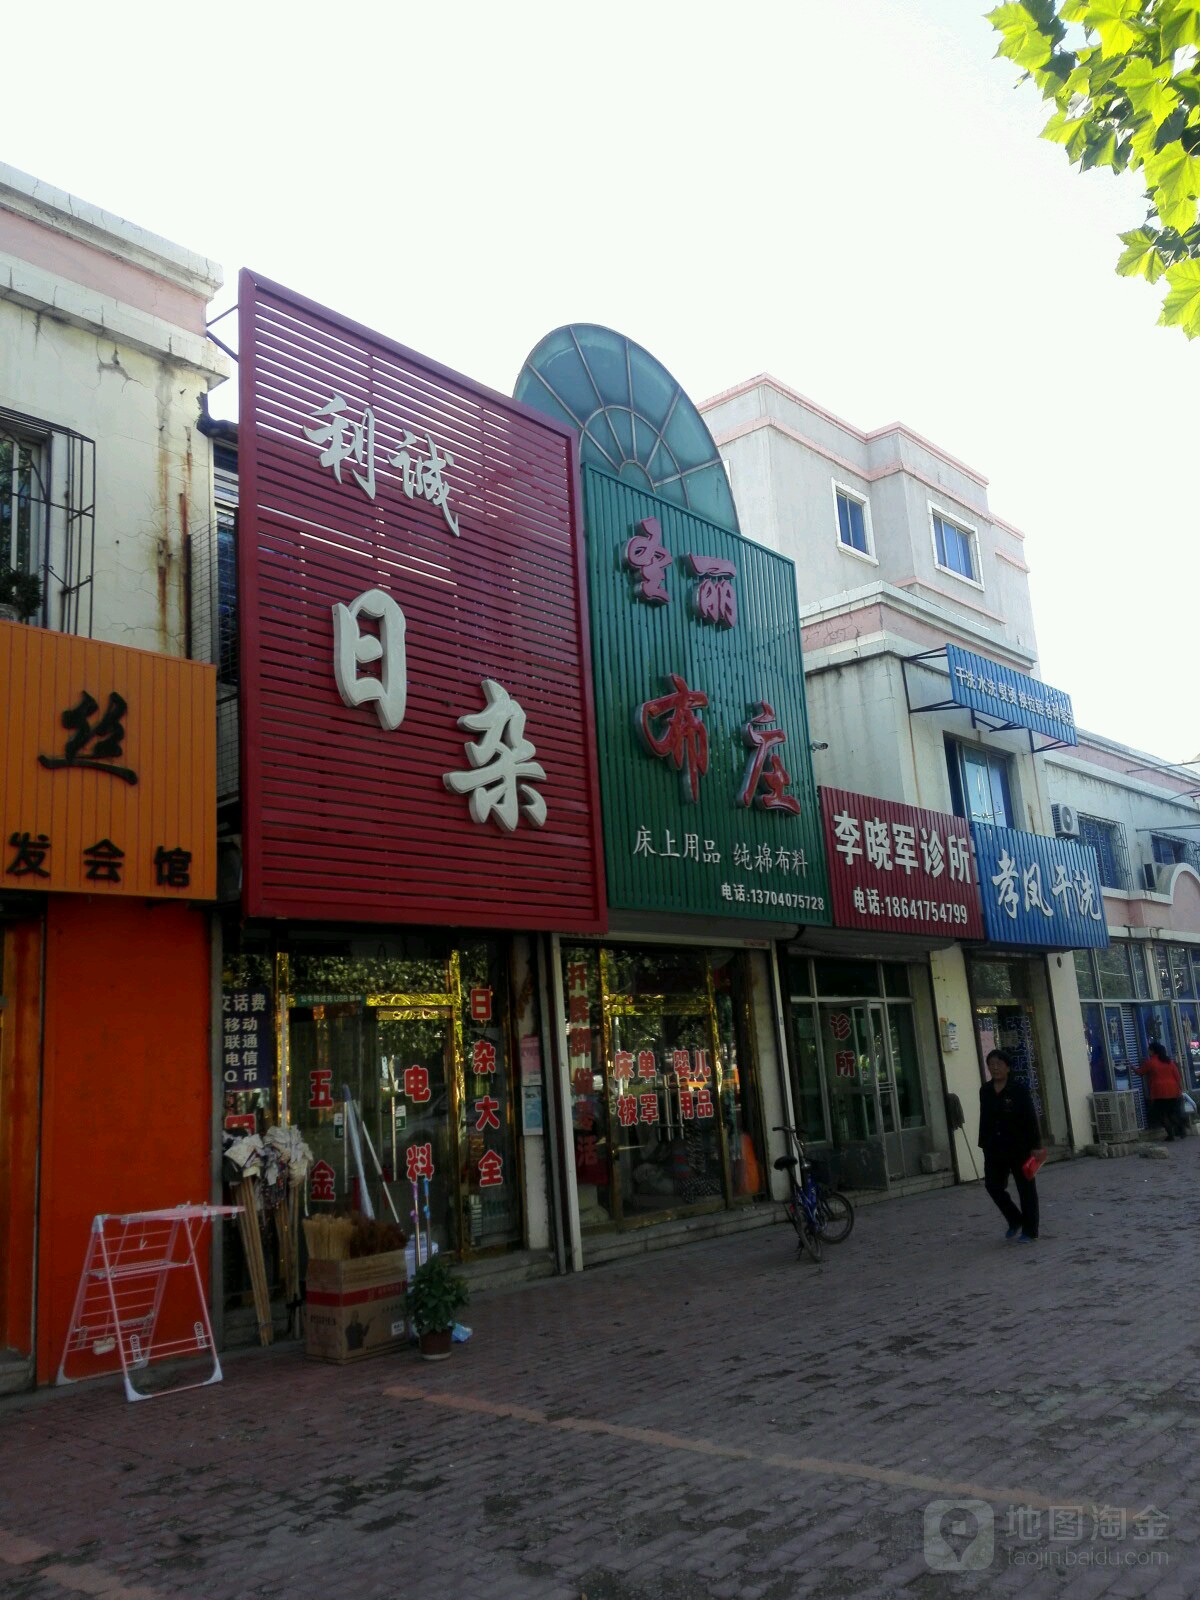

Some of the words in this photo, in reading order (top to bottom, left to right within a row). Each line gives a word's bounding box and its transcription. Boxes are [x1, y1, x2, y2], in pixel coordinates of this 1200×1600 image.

[955, 665, 977, 690] 干洗
[331, 588, 548, 833] 日杂
[37, 689, 139, 787] 丝
[635, 672, 801, 816] 布庄
[6, 831, 193, 888] 发会馆
[633, 825, 721, 864] 床上用品
[733, 842, 809, 879] 纯棉布料
[833, 810, 972, 885] 李晓军诊所
[721, 882, 825, 911] 电话:13704075728
[853, 886, 968, 925] 电话:18641754799
[224, 1017, 259, 1033] 移动
[224, 1034, 259, 1050] 联通
[225, 1050, 259, 1067] 电信
[673, 1049, 712, 1079] 婴儿
[830, 1012, 857, 1078] 诊所
[224, 1067, 258, 1083] Q币
[614, 1050, 657, 1081] 床单
[470, 987, 504, 1188] 日杂大全
[680, 1089, 714, 1119] 用品
[404, 1064, 435, 1183] 电料
[616, 1093, 660, 1126] 被罩
[309, 1069, 337, 1203] 五金
